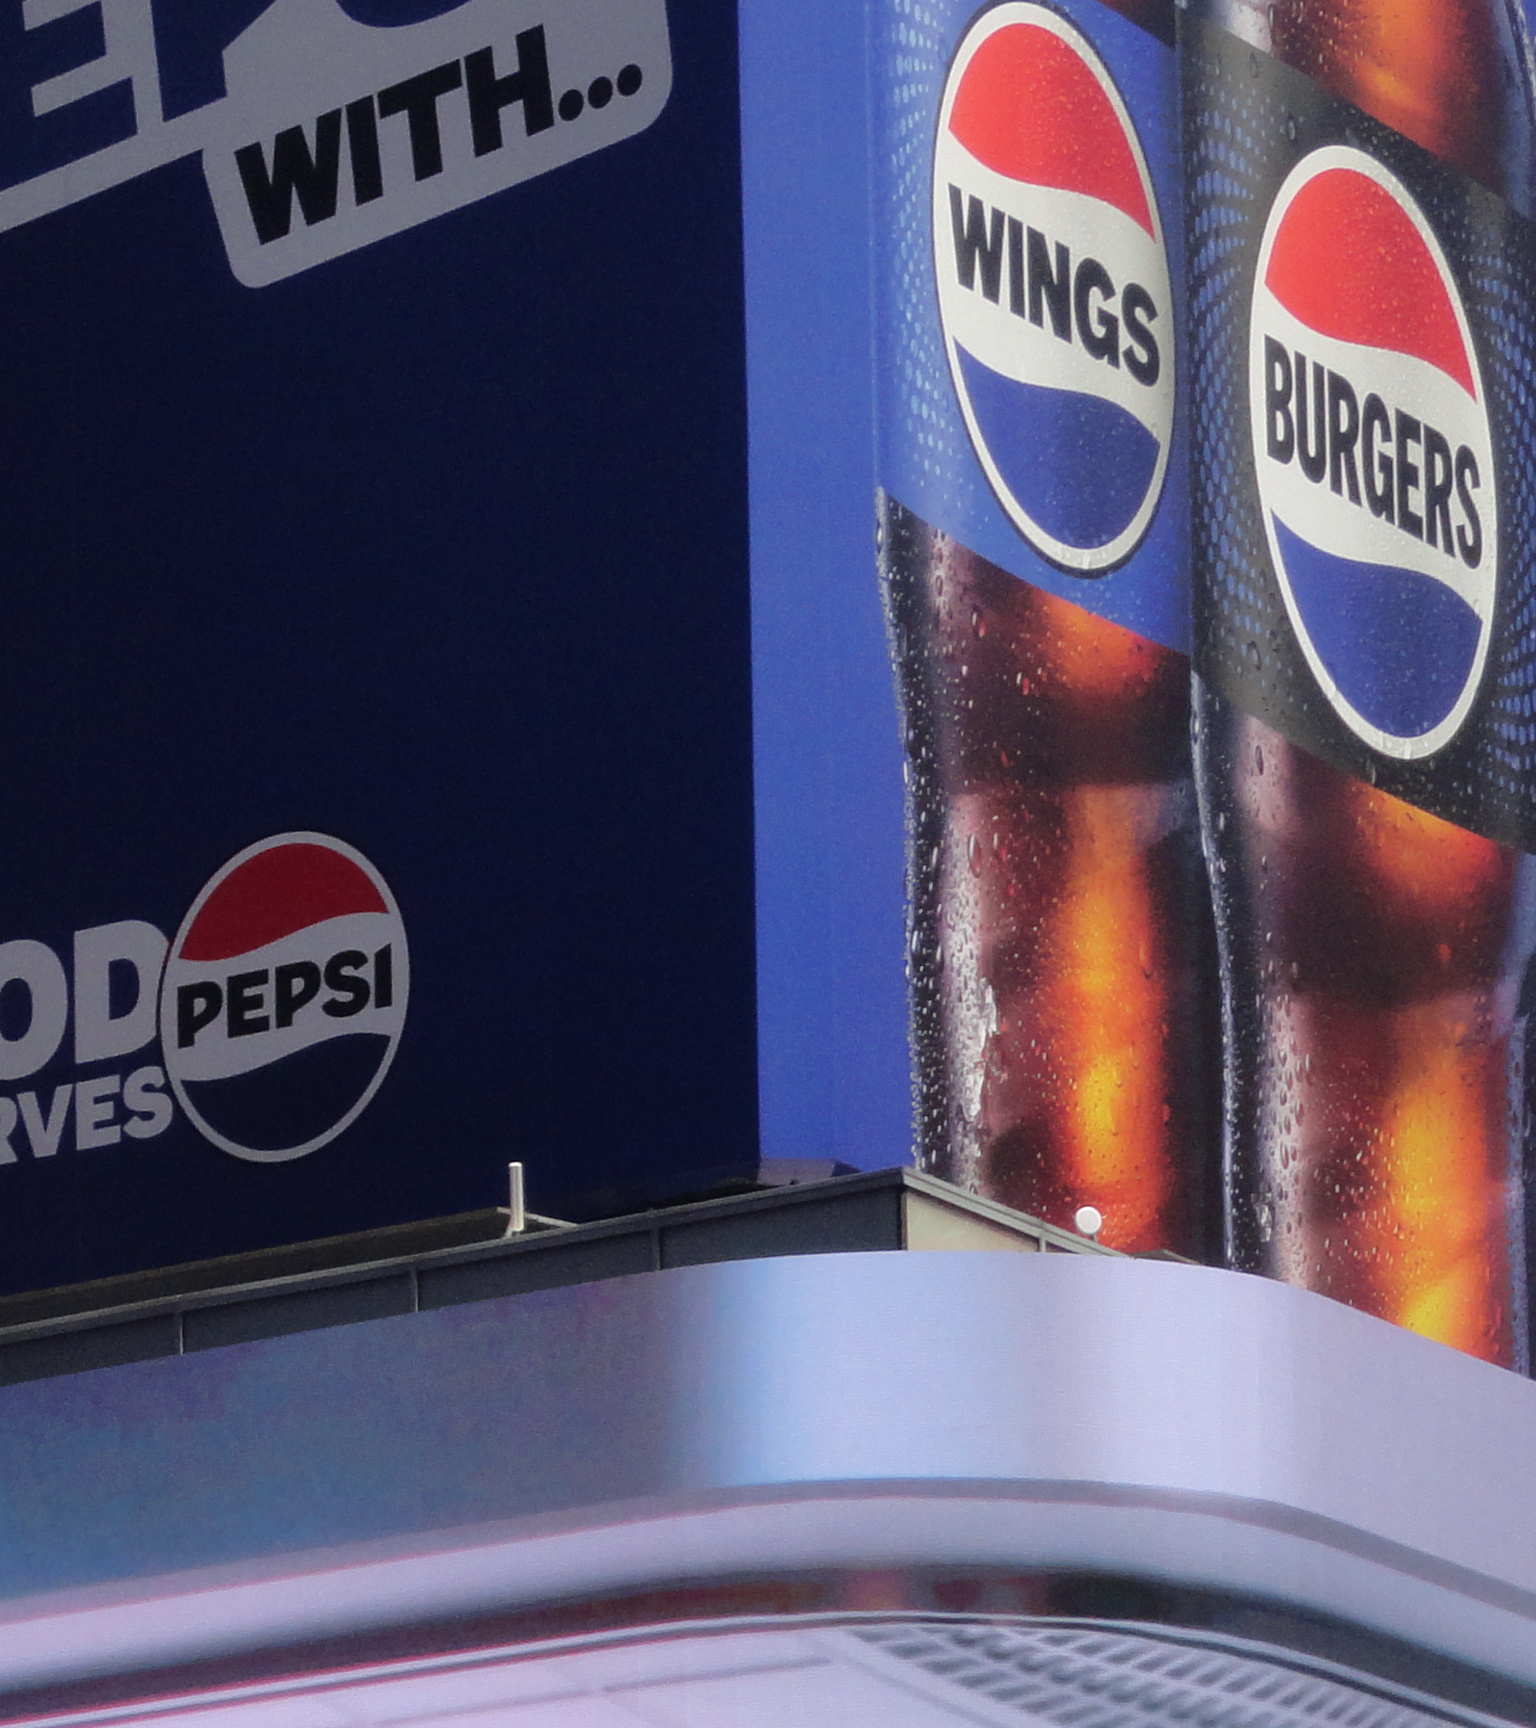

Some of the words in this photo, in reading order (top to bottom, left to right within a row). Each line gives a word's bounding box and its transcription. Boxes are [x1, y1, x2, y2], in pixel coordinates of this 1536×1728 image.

[234, 24, 642, 246] WITH...
[947, 184, 1161, 388] WINGS
[1263, 332, 1483, 571] BURGERS
[176, 942, 393, 1049] PEPSI
